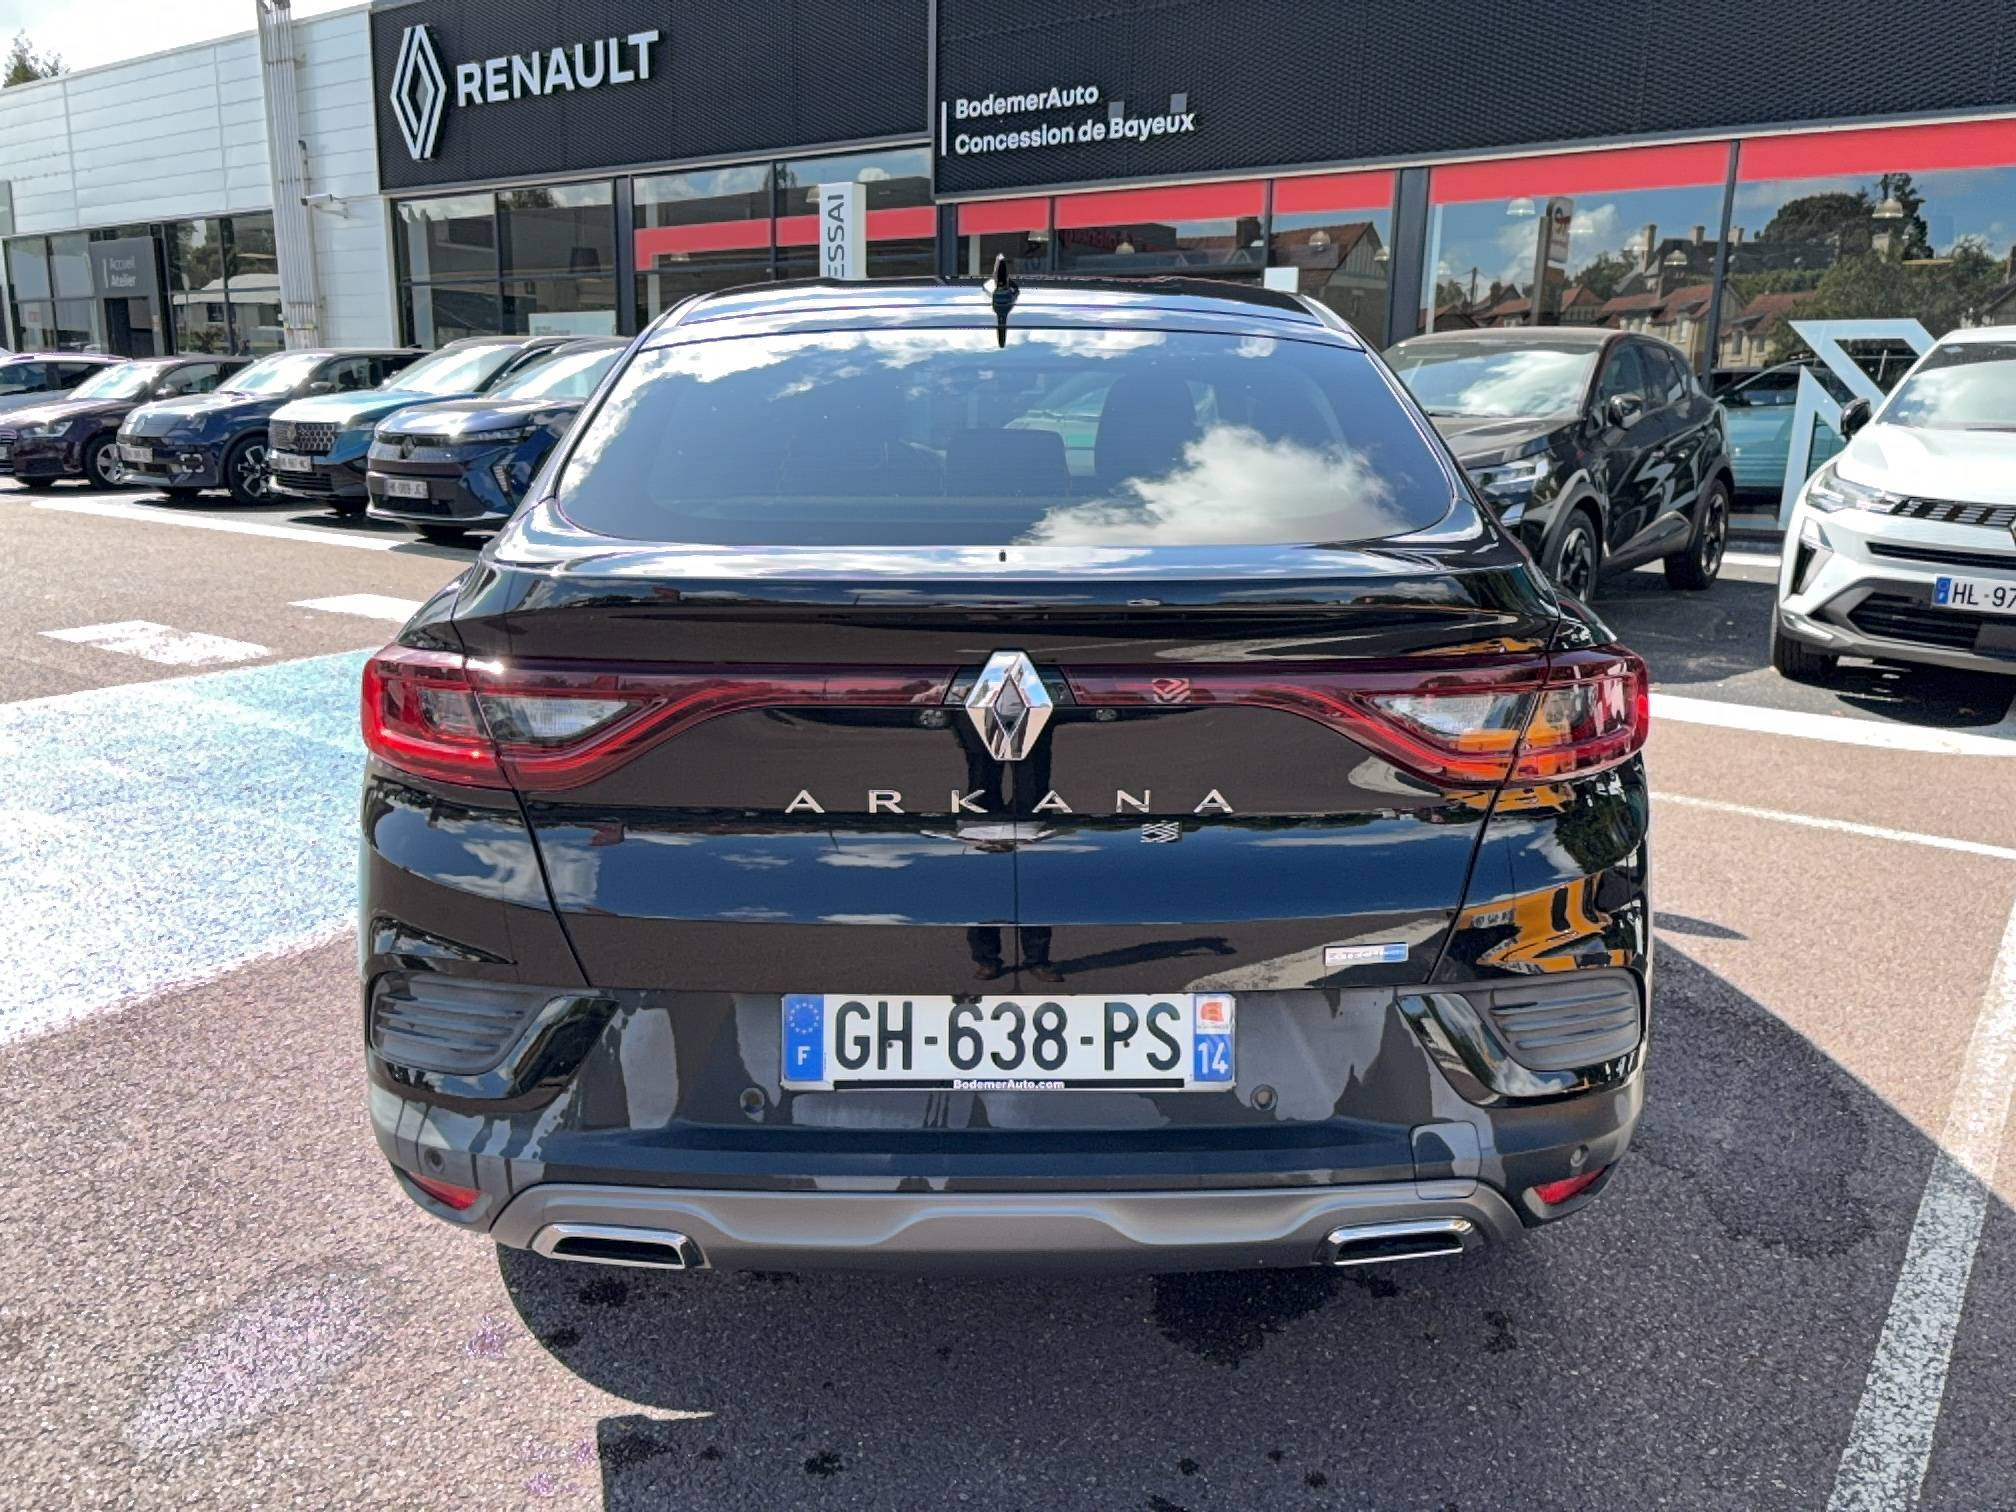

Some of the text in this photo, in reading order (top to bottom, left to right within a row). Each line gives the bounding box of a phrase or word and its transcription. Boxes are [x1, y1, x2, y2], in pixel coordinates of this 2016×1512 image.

[456, 30, 659, 107] RENAULT
[955, 86, 1099, 119] BodemerAuto
[955, 113, 1196, 155] Concession de Bayeux
[784, 789, 1234, 814] ARKANA
[835, 1001, 1181, 1071] GH-638-PS
[797, 1046, 811, 1066] F
[1198, 1042, 1229, 1074] 14
[953, 1079, 1065, 1089] BodemerAuto.com
